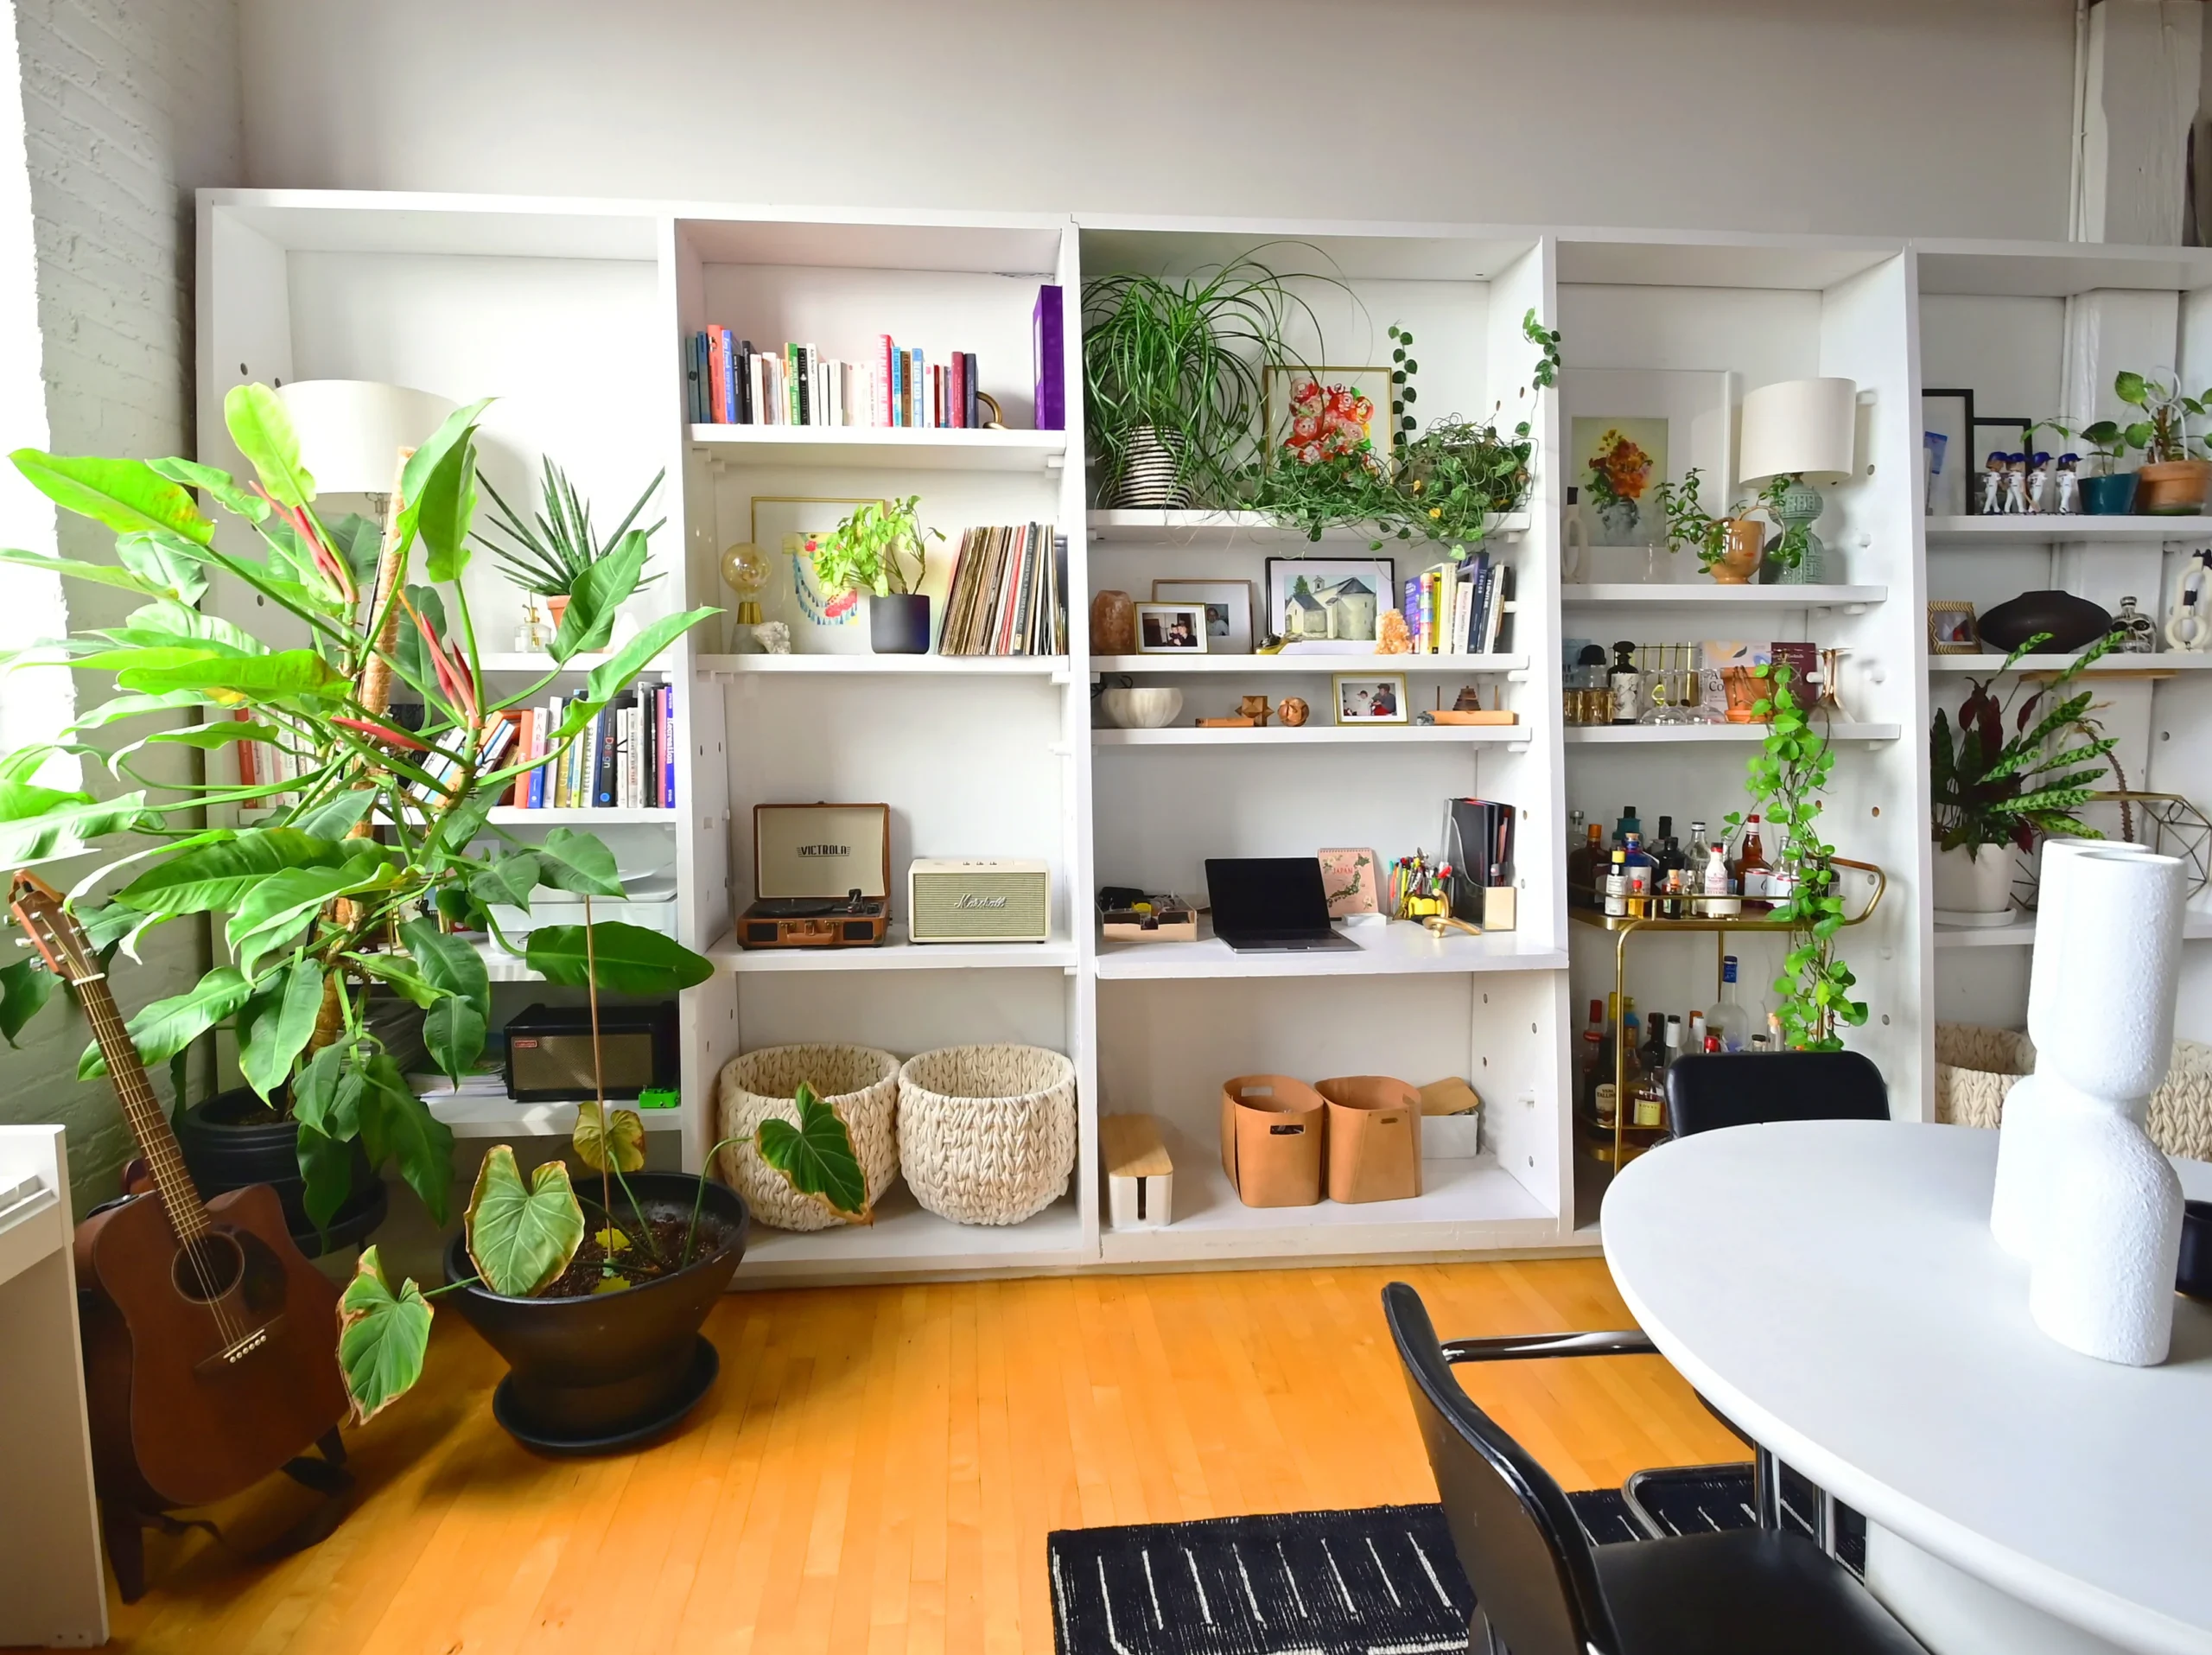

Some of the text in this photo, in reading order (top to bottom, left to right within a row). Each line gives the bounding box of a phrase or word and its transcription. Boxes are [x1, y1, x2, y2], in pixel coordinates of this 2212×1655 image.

[602, 737, 614, 768] Design
[583, 764, 592, 792] BELLES
[800, 844, 848, 856] VICTROLA
[1332, 866, 1353, 875] JAPAN
[953, 893, 1007, 909] Marshall
